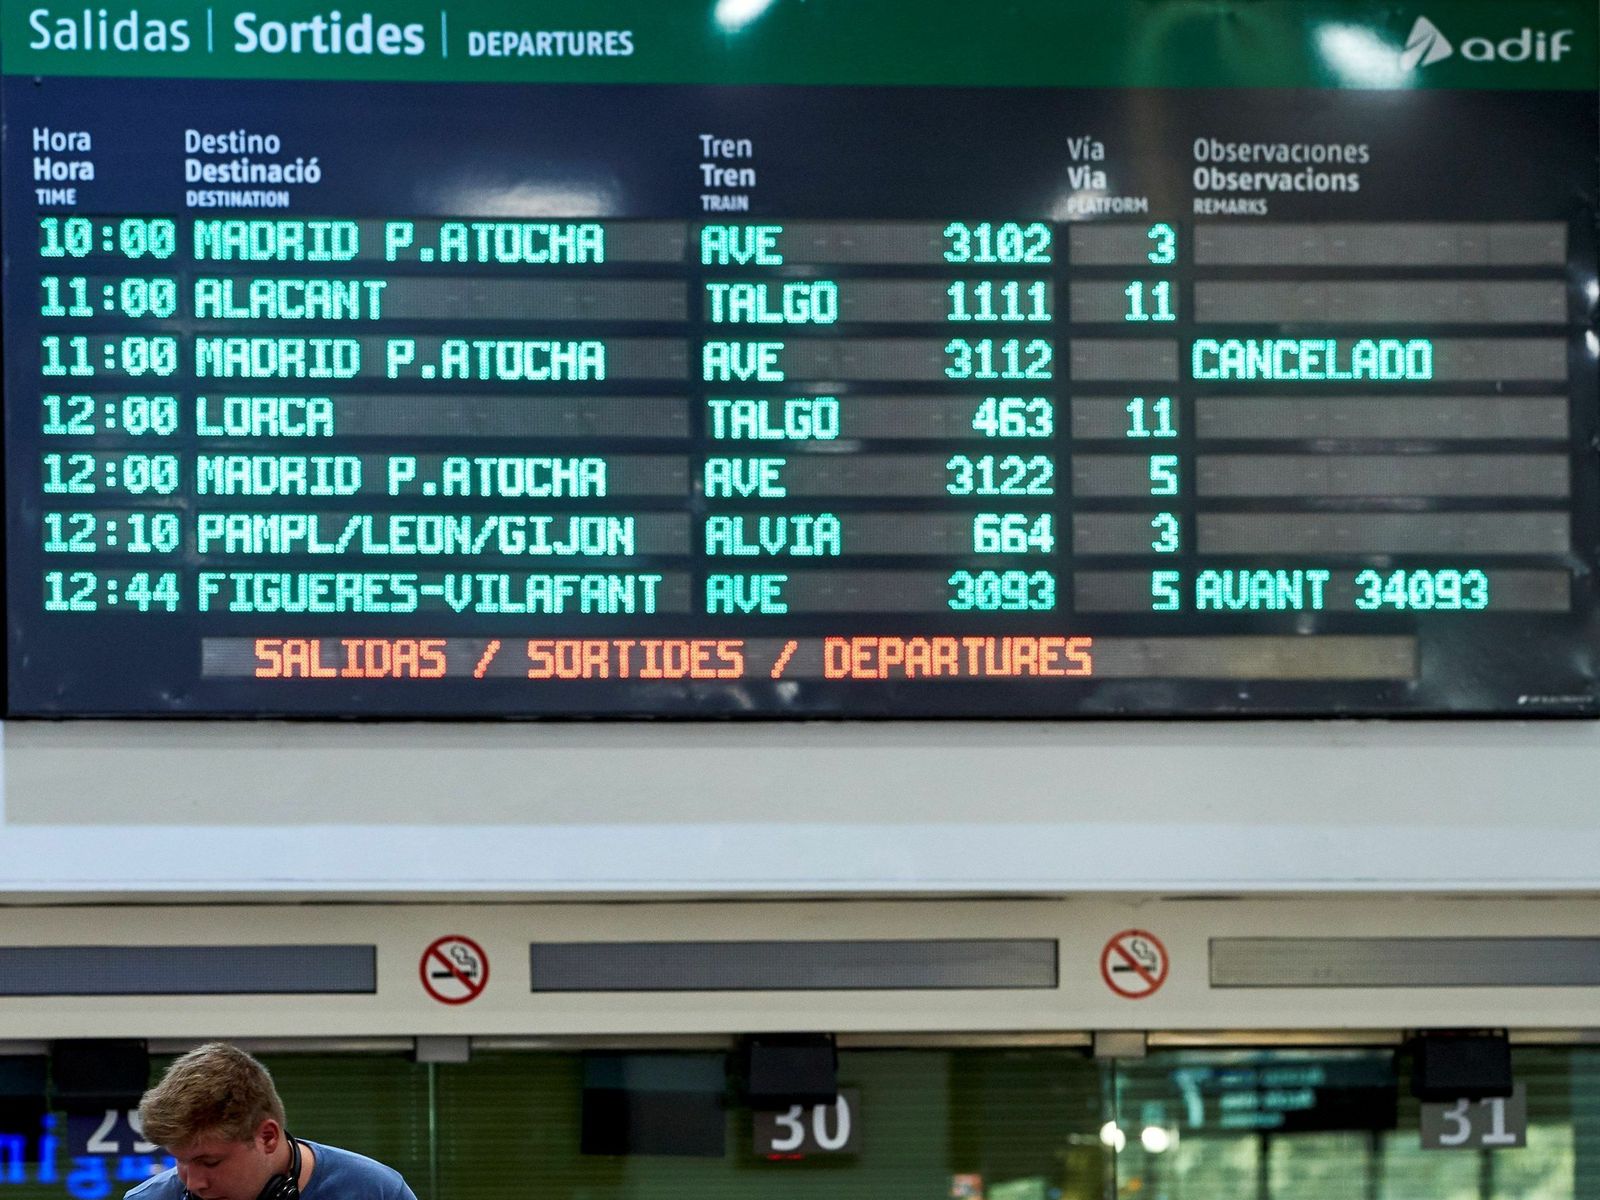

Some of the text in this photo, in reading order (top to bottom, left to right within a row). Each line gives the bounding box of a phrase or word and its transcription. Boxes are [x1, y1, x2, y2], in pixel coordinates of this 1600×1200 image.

[29, 9, 634, 57] Salidas Sortides DEPARTURES
[1460, 28, 1574, 62] adif
[33, 127, 91, 152] Hora
[185, 129, 281, 154] Destino
[699, 134, 752, 158] Tren
[1067, 136, 1105, 161] Vía
[1193, 138, 1370, 164] Observaciones
[33, 157, 95, 181] Hora
[185, 157, 321, 184] Destinació
[700, 163, 756, 187] Tren
[1067, 166, 1107, 190] Via
[1193, 167, 1360, 192] Observacions
[35, 188, 77, 206] TIME
[186, 190, 289, 208] DESTINATION
[700, 195, 749, 212] TRAIN
[1066, 197, 1149, 214] PLATFORM
[1193, 198, 1268, 215] REMARKS
[41, 218, 1177, 266] 10:00 MADRID P.ATOCHA AVE 3102 3
[42, 277, 1177, 325] 11:00 ALACANT TALGO 1111 11
[43, 337, 1434, 383] 11:00 MADRID P.ATOCHA AVE 3112 CANCELADO
[44, 396, 1179, 441] 12:00 LORCA TALGO 463 11
[44, 455, 1179, 499] 12:00 MADRID P.ATOCHA AVE 3122 5
[45, 513, 1180, 557] 12:10 PAMPL/LEON/GIJON ALVIA 664 3
[46, 570, 1490, 615] 12:44 FIGUERES-VILAFANT AVE 3093 5 AVANT 34093
[256, 640, 448, 679] SALIDAS
[529, 641, 745, 680] SORTIDES
[825, 638, 1093, 680] DEPARTURES
[771, 1094, 851, 1151] 30
[1439, 1097, 1516, 1145] 31
